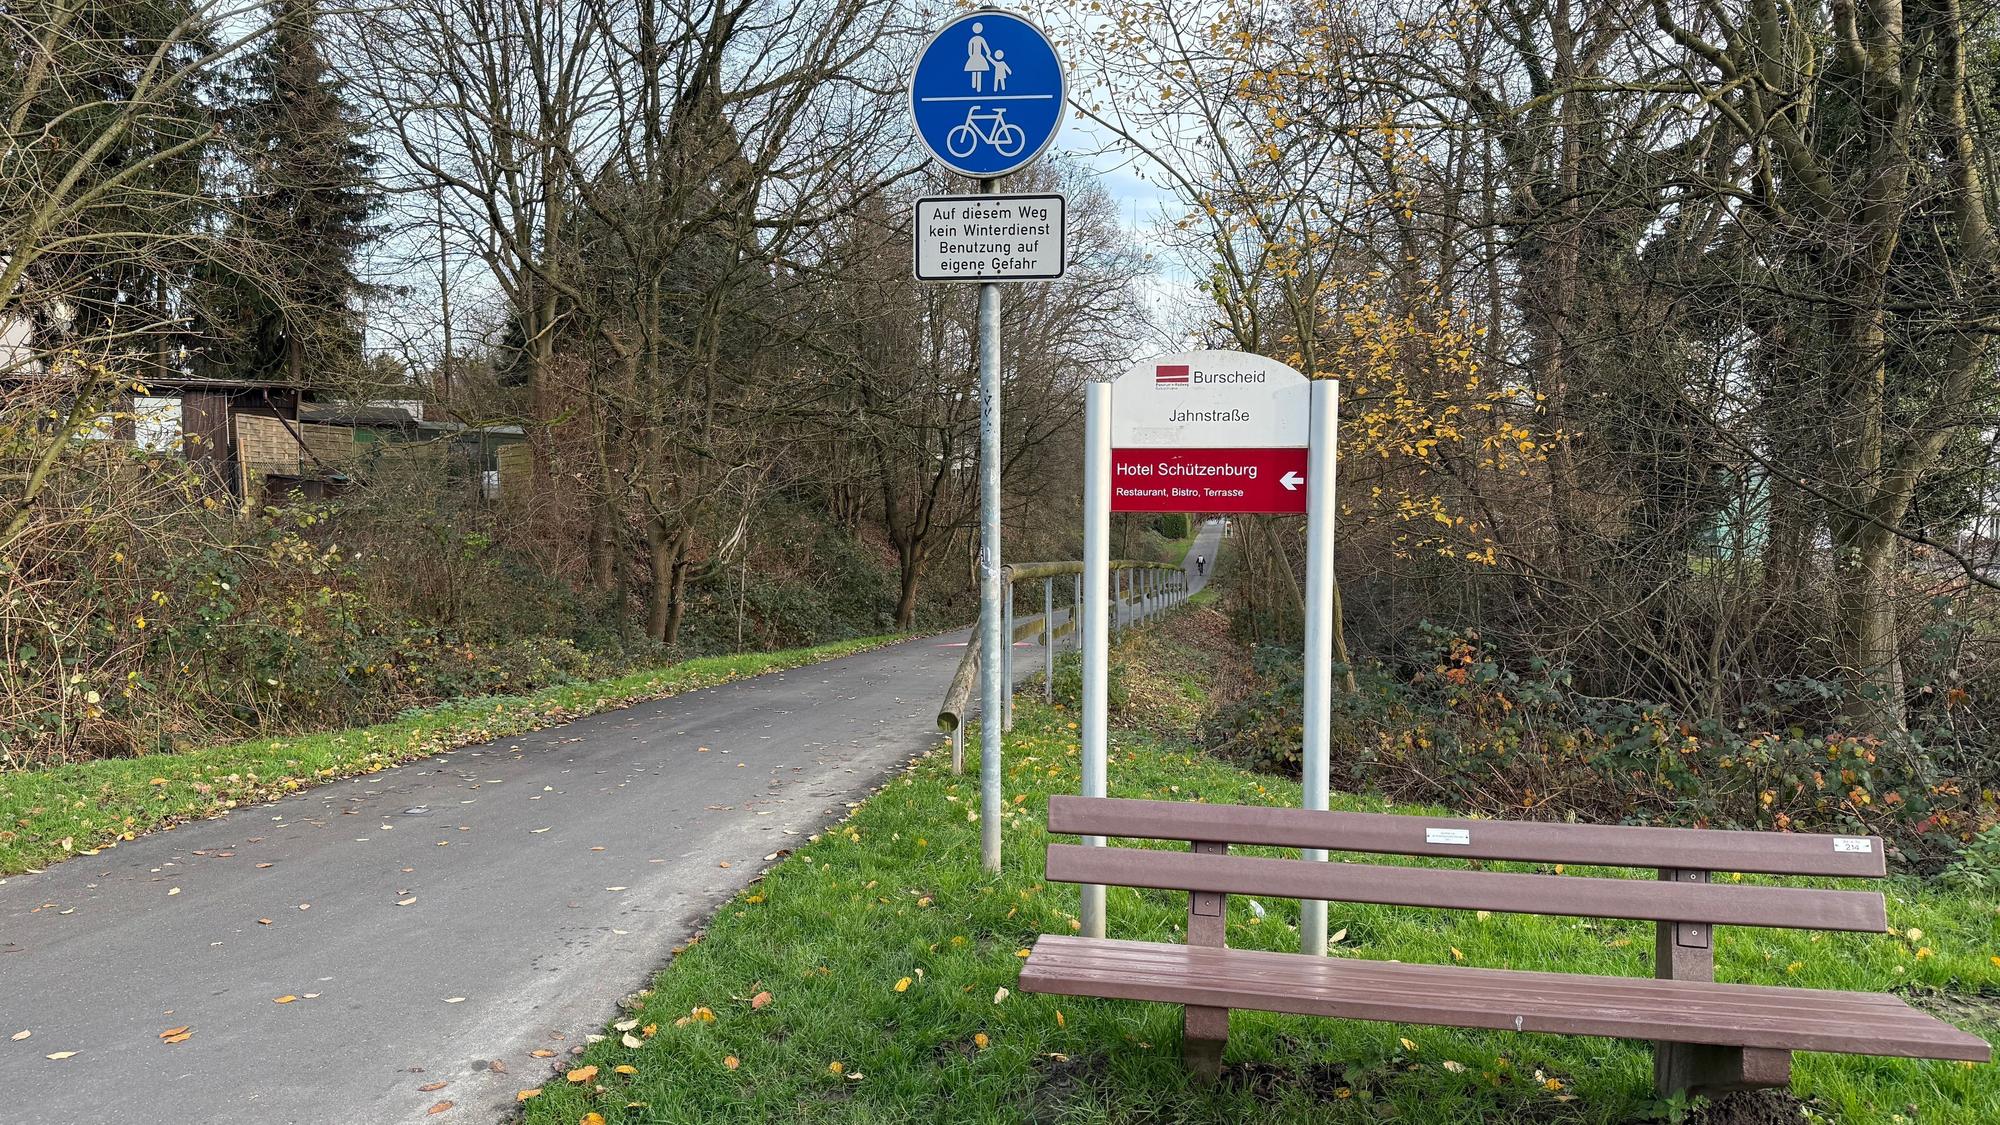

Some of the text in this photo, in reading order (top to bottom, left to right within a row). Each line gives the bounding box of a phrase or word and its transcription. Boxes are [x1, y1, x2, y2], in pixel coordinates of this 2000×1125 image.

[933, 206, 1048, 221] Auf diesem Weg
[929, 223, 1050, 237] kein Winterdienst
[940, 240, 1039, 255] Benutzung auf
[940, 257, 1037, 273] eigene Gefahr
[1193, 370, 1266, 384] Burscheid
[1169, 408, 1250, 422] Jahnstraße
[1116, 462, 1258, 479] Hotel Schützenburg
[1116, 487, 1244, 498] Restaurant, Bistro, Terrasse
